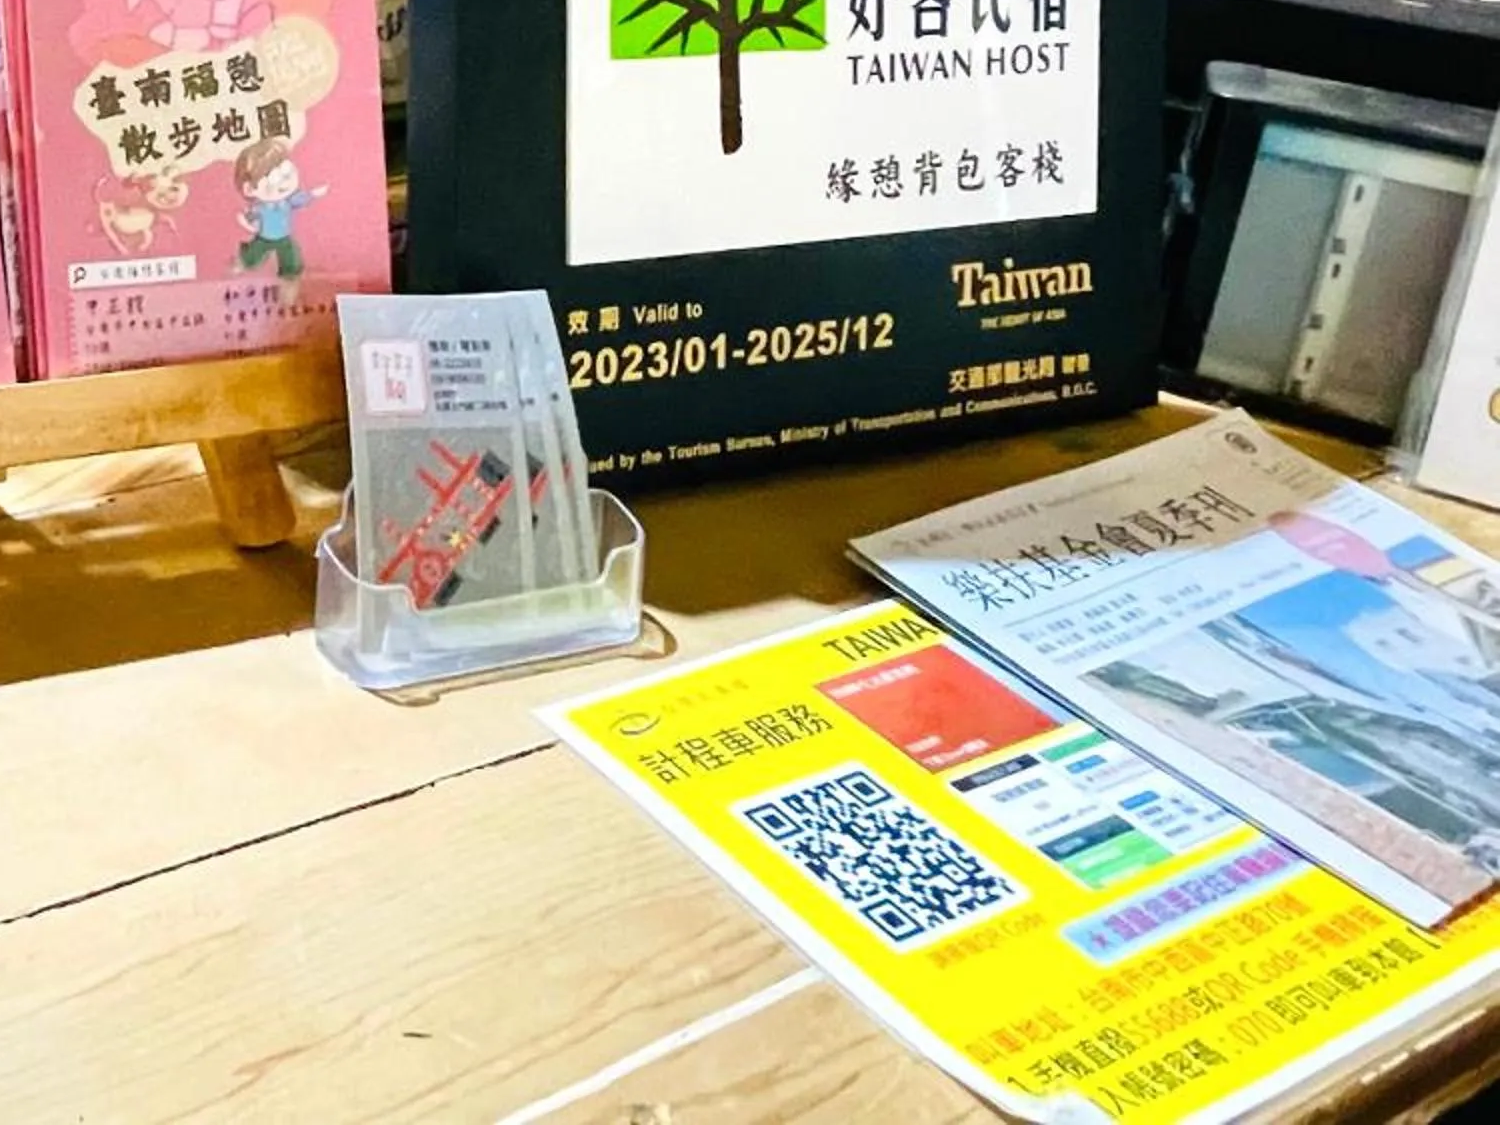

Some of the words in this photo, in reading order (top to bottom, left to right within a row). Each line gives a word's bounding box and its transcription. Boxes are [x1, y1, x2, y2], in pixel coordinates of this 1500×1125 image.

[89, 51, 264, 120] 臺南福憩
[846, 48, 973, 86] TAIWAN
[985, 41, 1071, 76] HOST
[119, 99, 291, 165] 散步地圖
[825, 140, 1064, 205] 緣憩背包客棧
[632, 304, 681, 326] Valid
[686, 300, 704, 319] to
[951, 258, 1094, 309] Taiwan
[569, 312, 894, 390] 2023/01-2025/12
[589, 455, 615, 474] ued
[620, 453, 637, 471] by
[641, 449, 663, 466] the
[668, 439, 721, 461] Tourism
[780, 423, 830, 445] Ministry
[833, 418, 848, 435] of
[940, 401, 963, 419] and
[822, 618, 939, 662] TAIWA
[639, 704, 834, 785] 計程車服務
